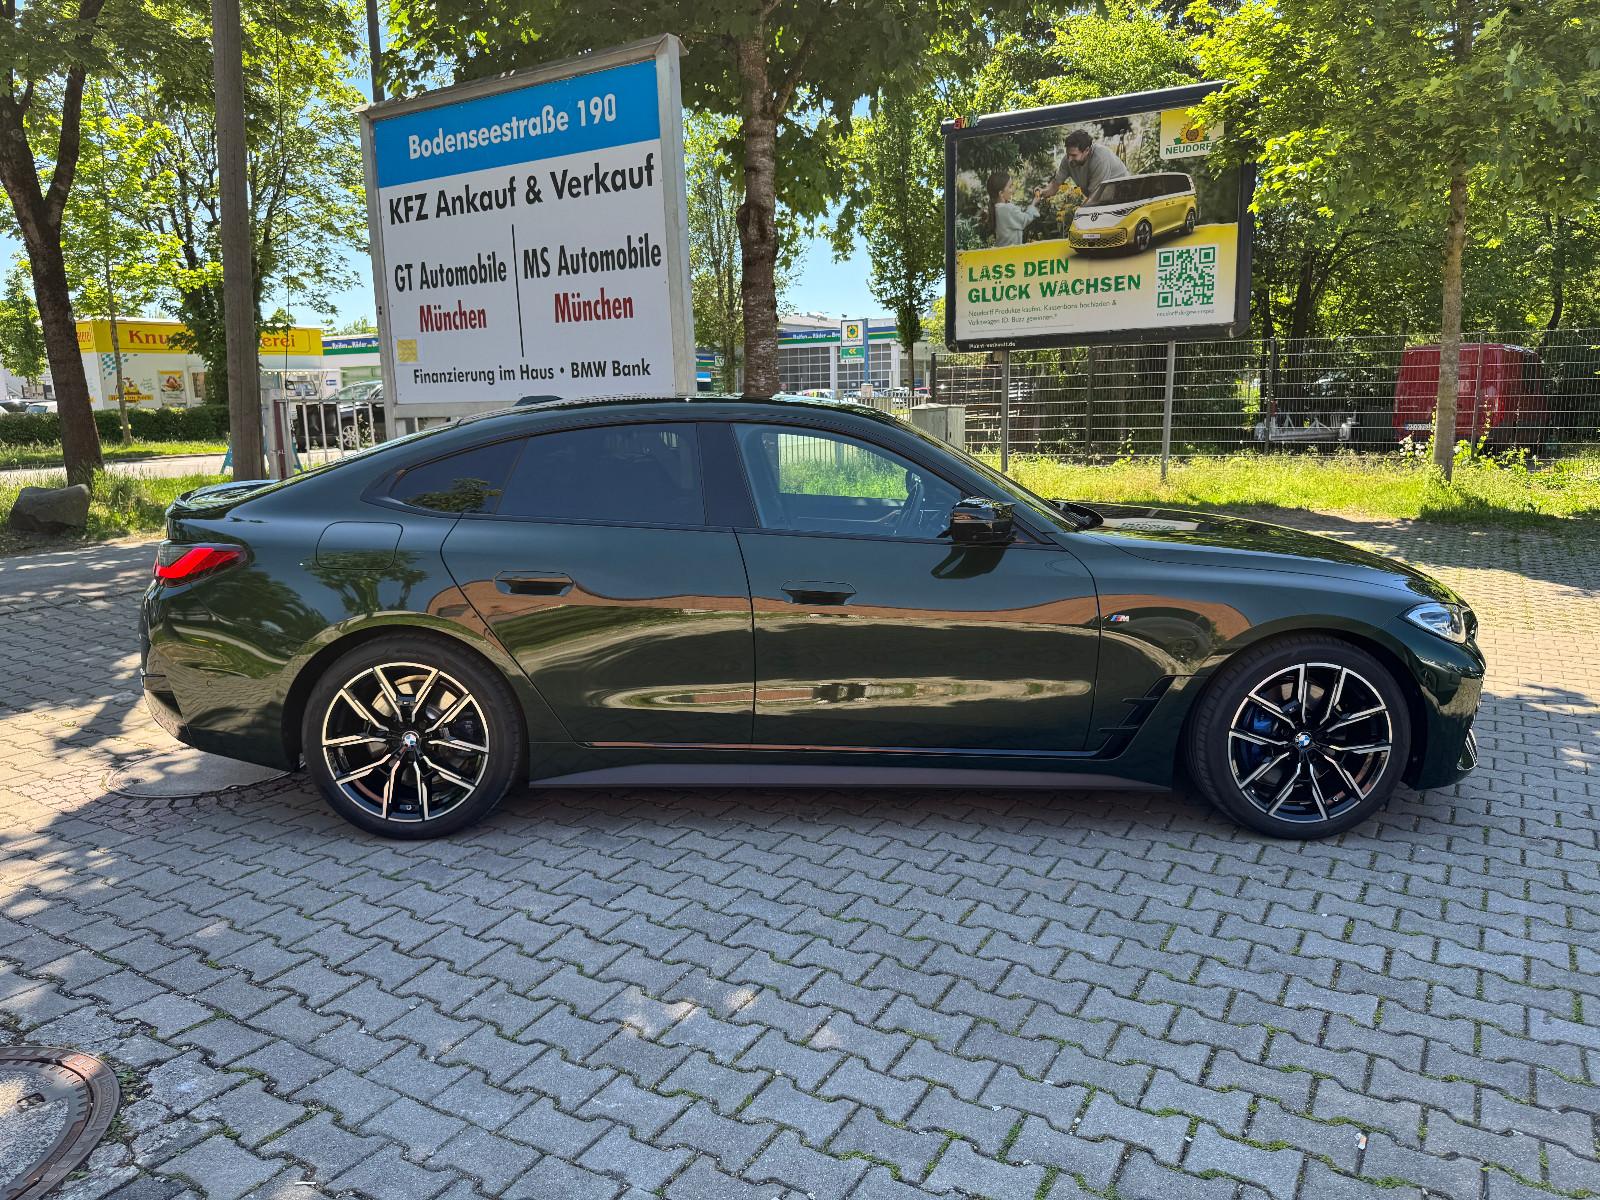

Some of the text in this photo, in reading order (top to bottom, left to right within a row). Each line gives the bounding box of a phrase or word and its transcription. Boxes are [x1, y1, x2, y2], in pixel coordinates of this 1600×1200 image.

[408, 93, 617, 160] Bodenseestraße 190
[1165, 142, 1213, 155] NEUDORF
[389, 152, 655, 226] KFZ Ankauf & Verkauf
[394, 251, 508, 293] GT Automobile
[523, 232, 662, 280] MS Automobile
[968, 258, 1070, 283] LASS DEIN
[967, 273, 1141, 304] GLÜCK WACHSEN
[419, 299, 488, 333] München
[554, 287, 634, 324] München
[995, 307, 1020, 315] Produkte
[128, 330, 296, 348] Knu erei
[413, 357, 651, 386] Finanzierung im Haus BMW Bank
